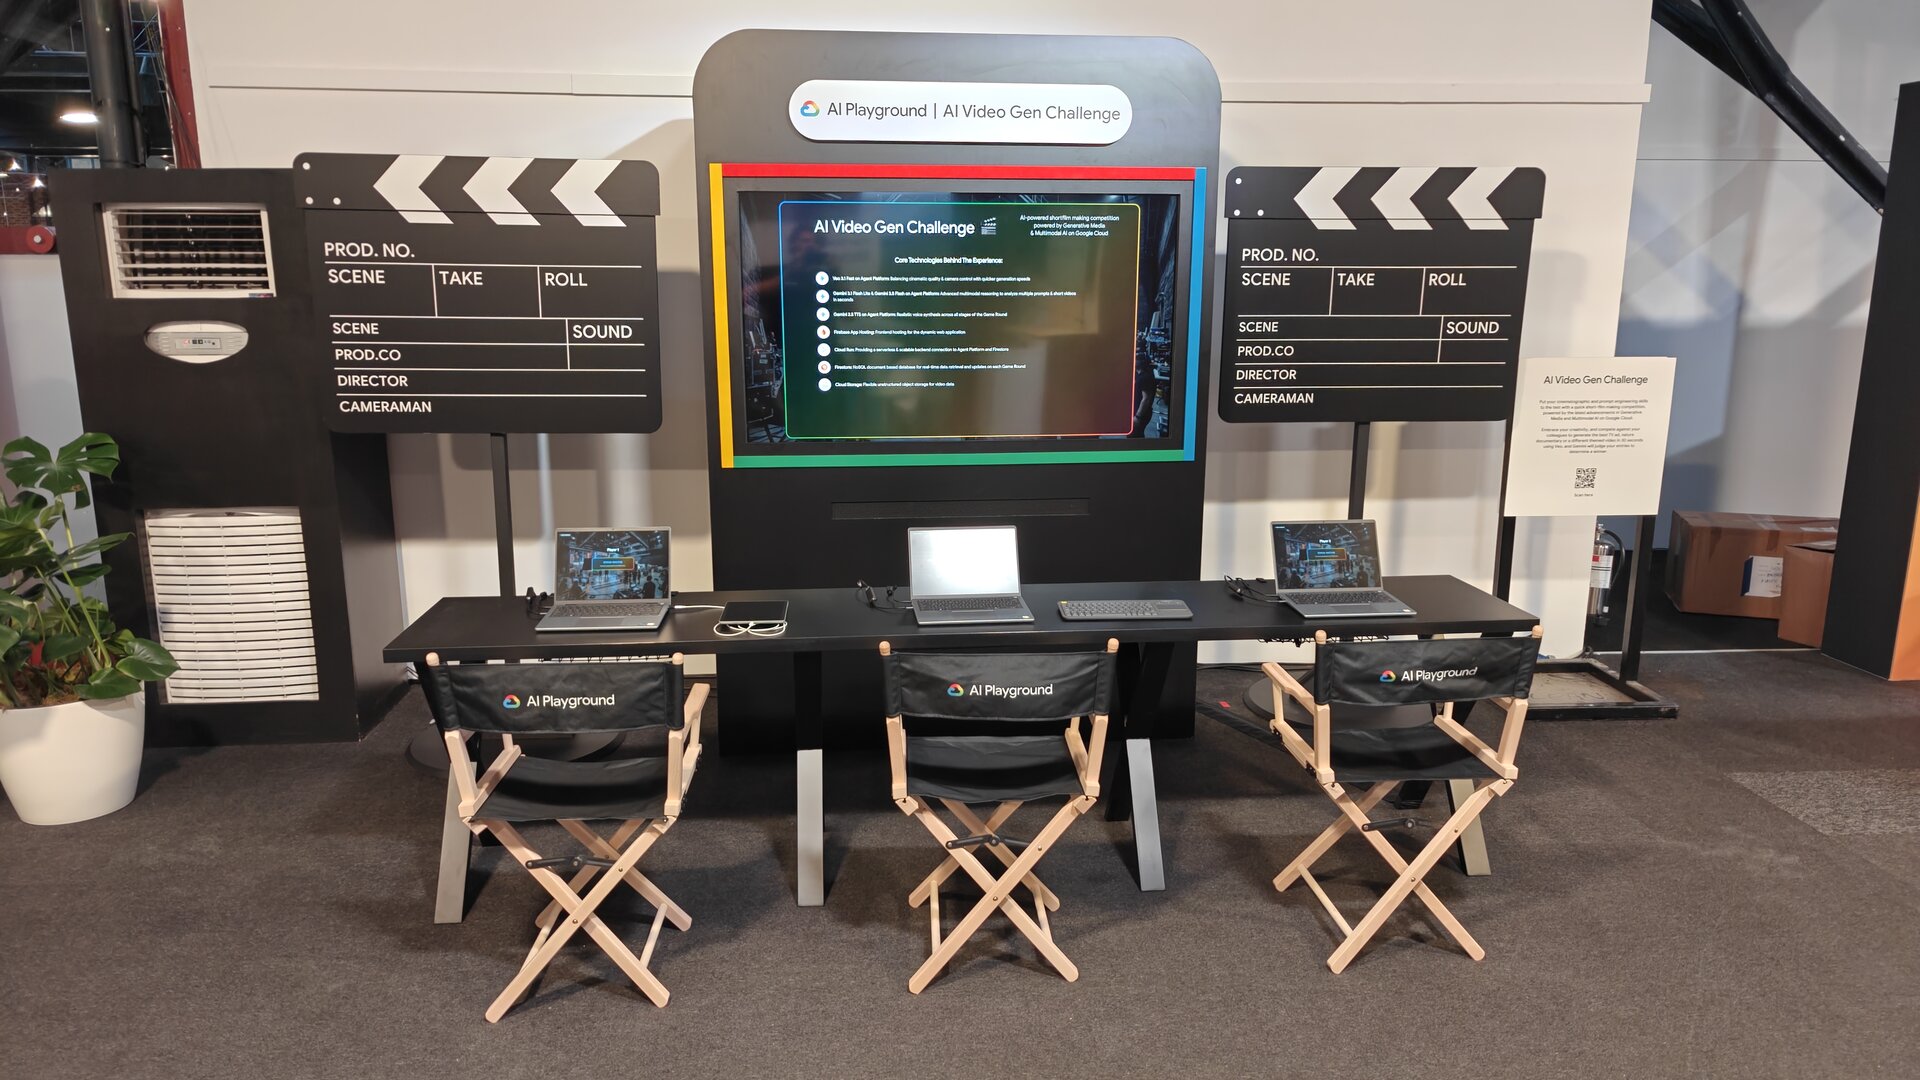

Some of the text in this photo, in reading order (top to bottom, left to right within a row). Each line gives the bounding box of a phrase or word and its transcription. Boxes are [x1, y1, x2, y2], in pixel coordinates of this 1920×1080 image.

[827, 103, 842, 116] AI
[846, 102, 928, 120] Playground
[943, 104, 958, 118] AI
[962, 104, 1006, 119] Video
[1010, 105, 1042, 119] Gen
[1046, 105, 1121, 124] Challenge
[814, 220, 976, 238] AI Video Gen Challenge
[324, 242, 415, 258] PROD. NO.
[1241, 248, 1320, 262] PROD. NO.
[908, 256, 942, 264] Technologies
[328, 269, 385, 284] SCENE
[439, 271, 483, 285] TAKE
[545, 272, 588, 286] ROLL
[1241, 273, 1291, 286] SCENE
[1337, 273, 1375, 286] TAKE
[1428, 273, 1467, 286] ROLL
[332, 322, 379, 334] SCENE
[572, 325, 633, 339] SOUND
[1238, 321, 1279, 333] SCENE
[1446, 321, 1500, 334] SOUND
[335, 349, 401, 361] PROD.CO
[1237, 346, 1294, 357] PROD.CO
[337, 375, 408, 387] DIRECTOR
[1236, 369, 1297, 380] DIRECTOR
[1544, 375, 1648, 385] AI Video Gen Challenge
[1234, 393, 1314, 404] CAMERAMAN
[339, 401, 432, 413] CAMERAMAN
[1401, 667, 1478, 681] AI Playground
[969, 684, 1053, 698] AI Playground
[527, 694, 615, 709] AI Playground
